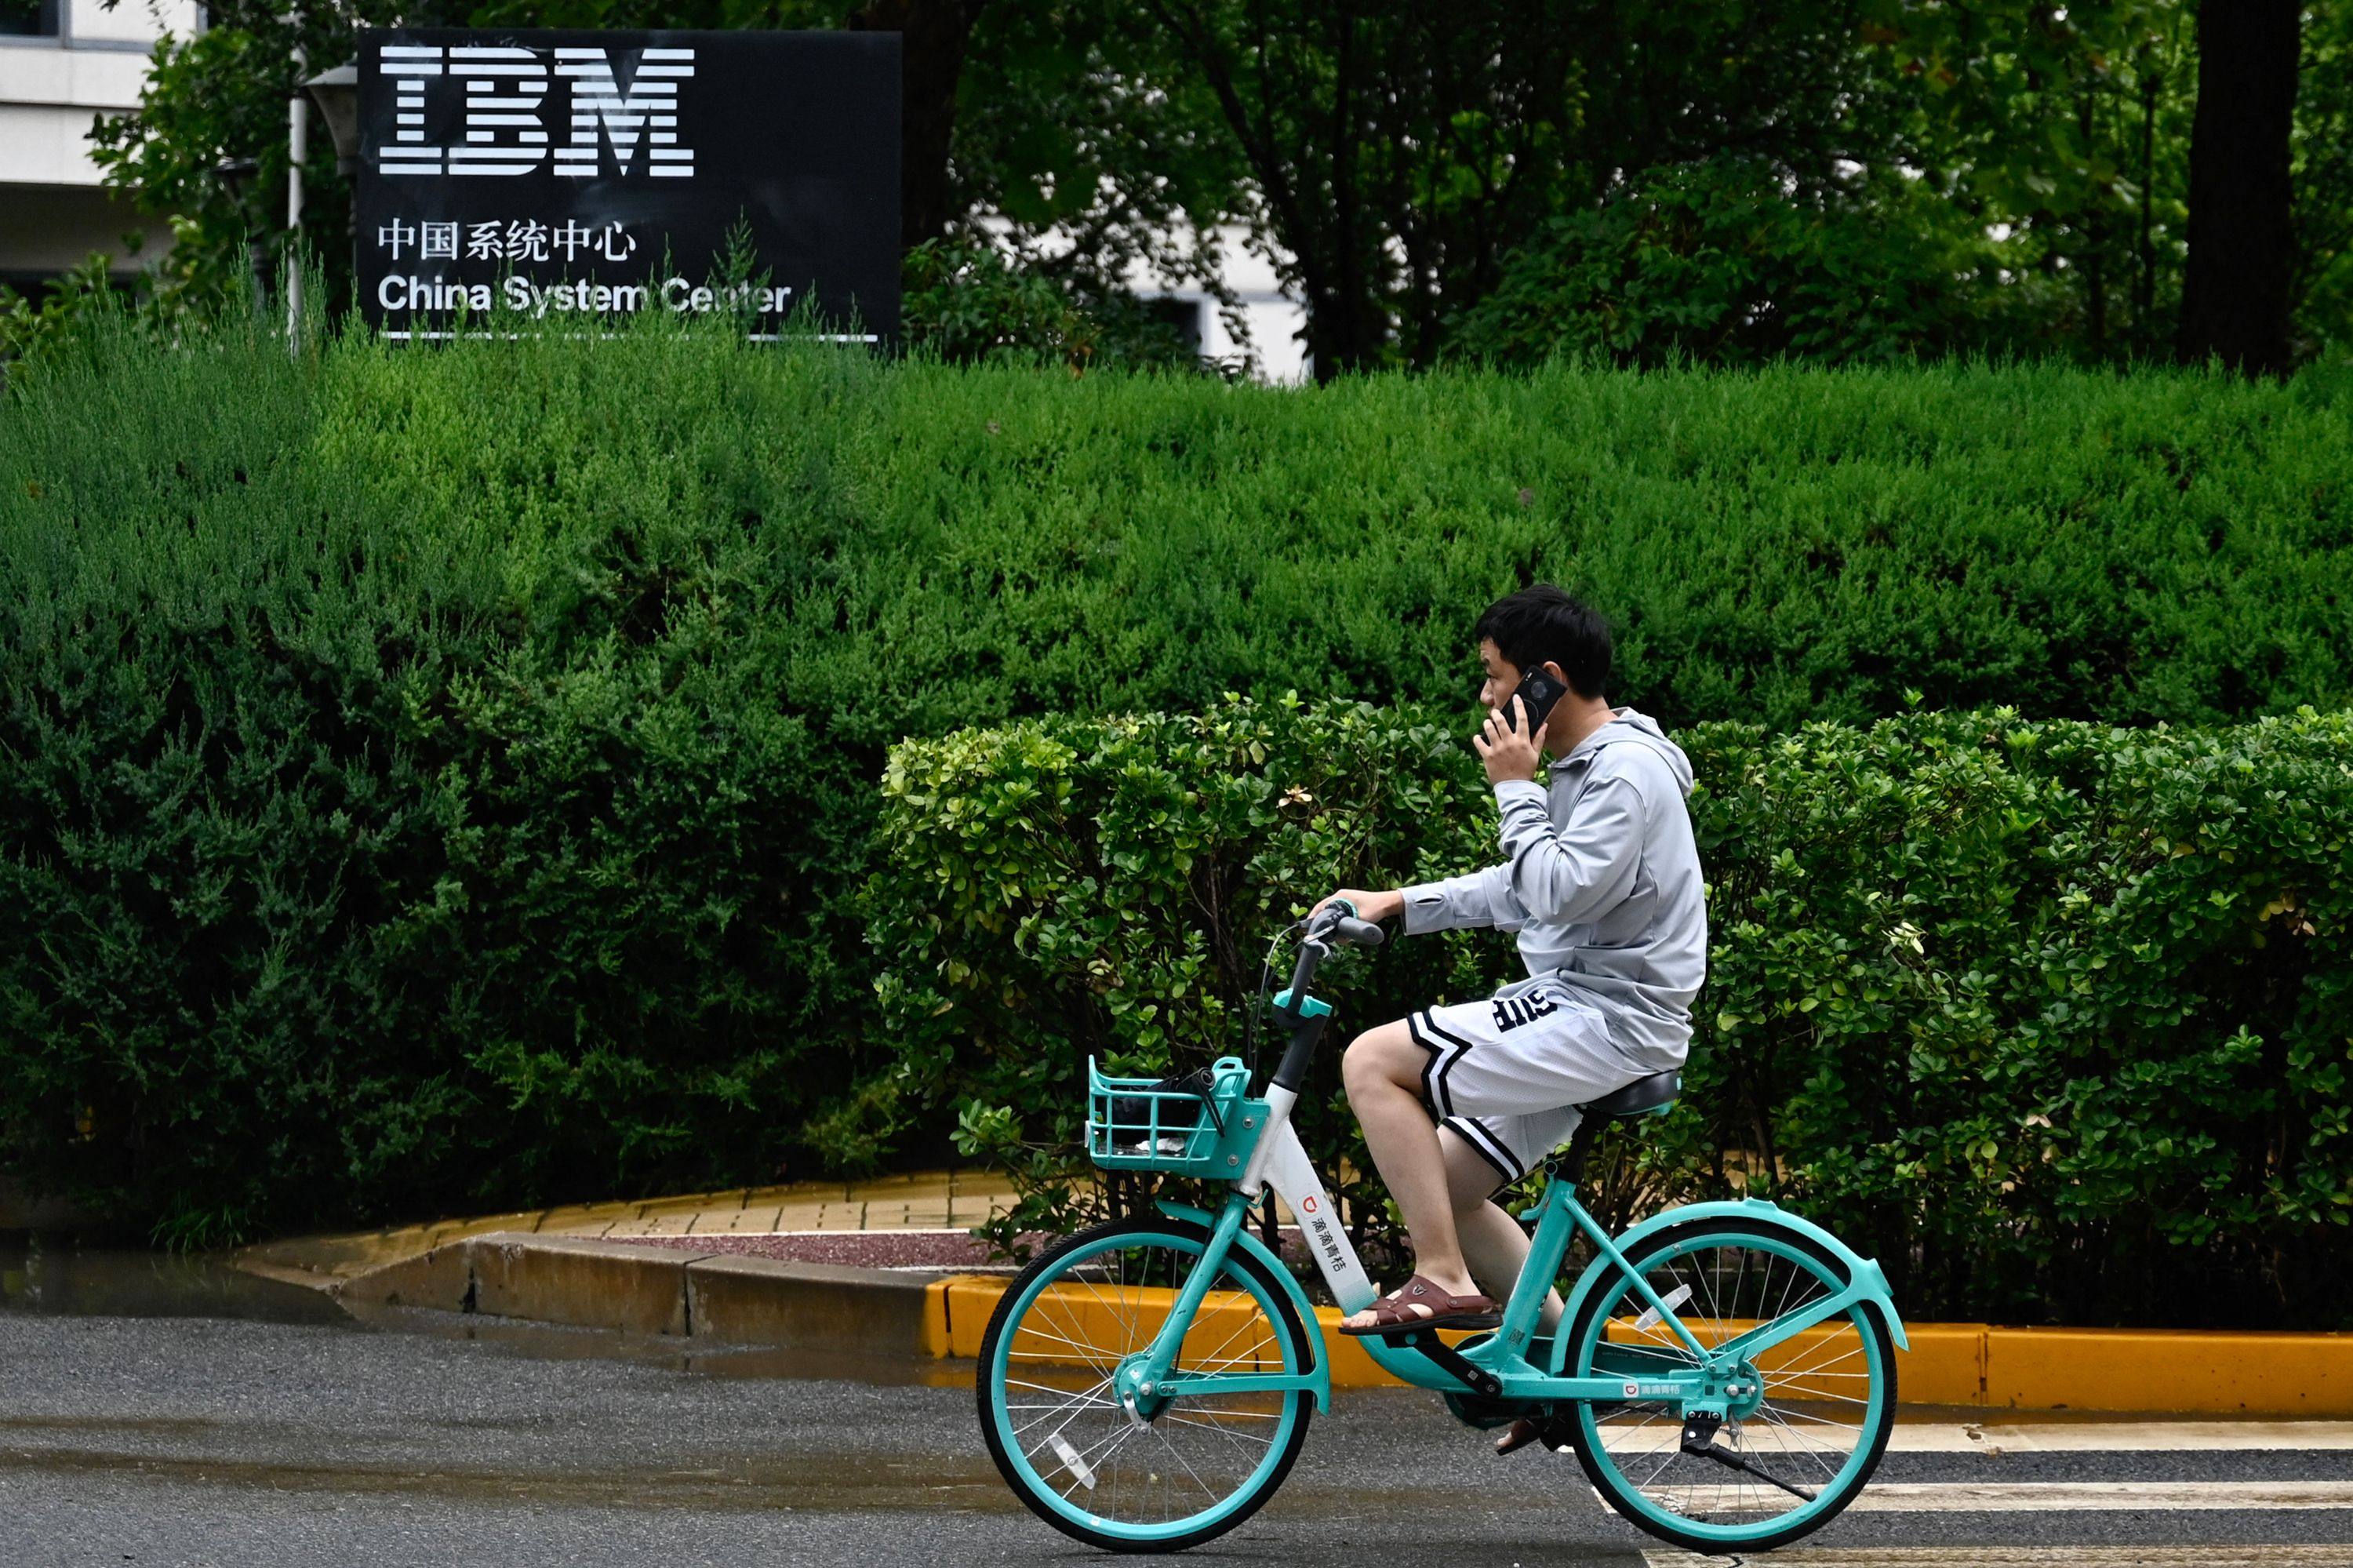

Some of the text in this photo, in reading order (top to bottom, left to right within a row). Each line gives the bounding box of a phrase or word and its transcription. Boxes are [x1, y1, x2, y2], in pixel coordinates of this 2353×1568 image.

[379, 45, 695, 177] IBM
[377, 217, 637, 263] 中国系统中心
[377, 275, 491, 311] China
[504, 275, 649, 319] System
[1311, 1217, 1347, 1272] 滴滴青桔
